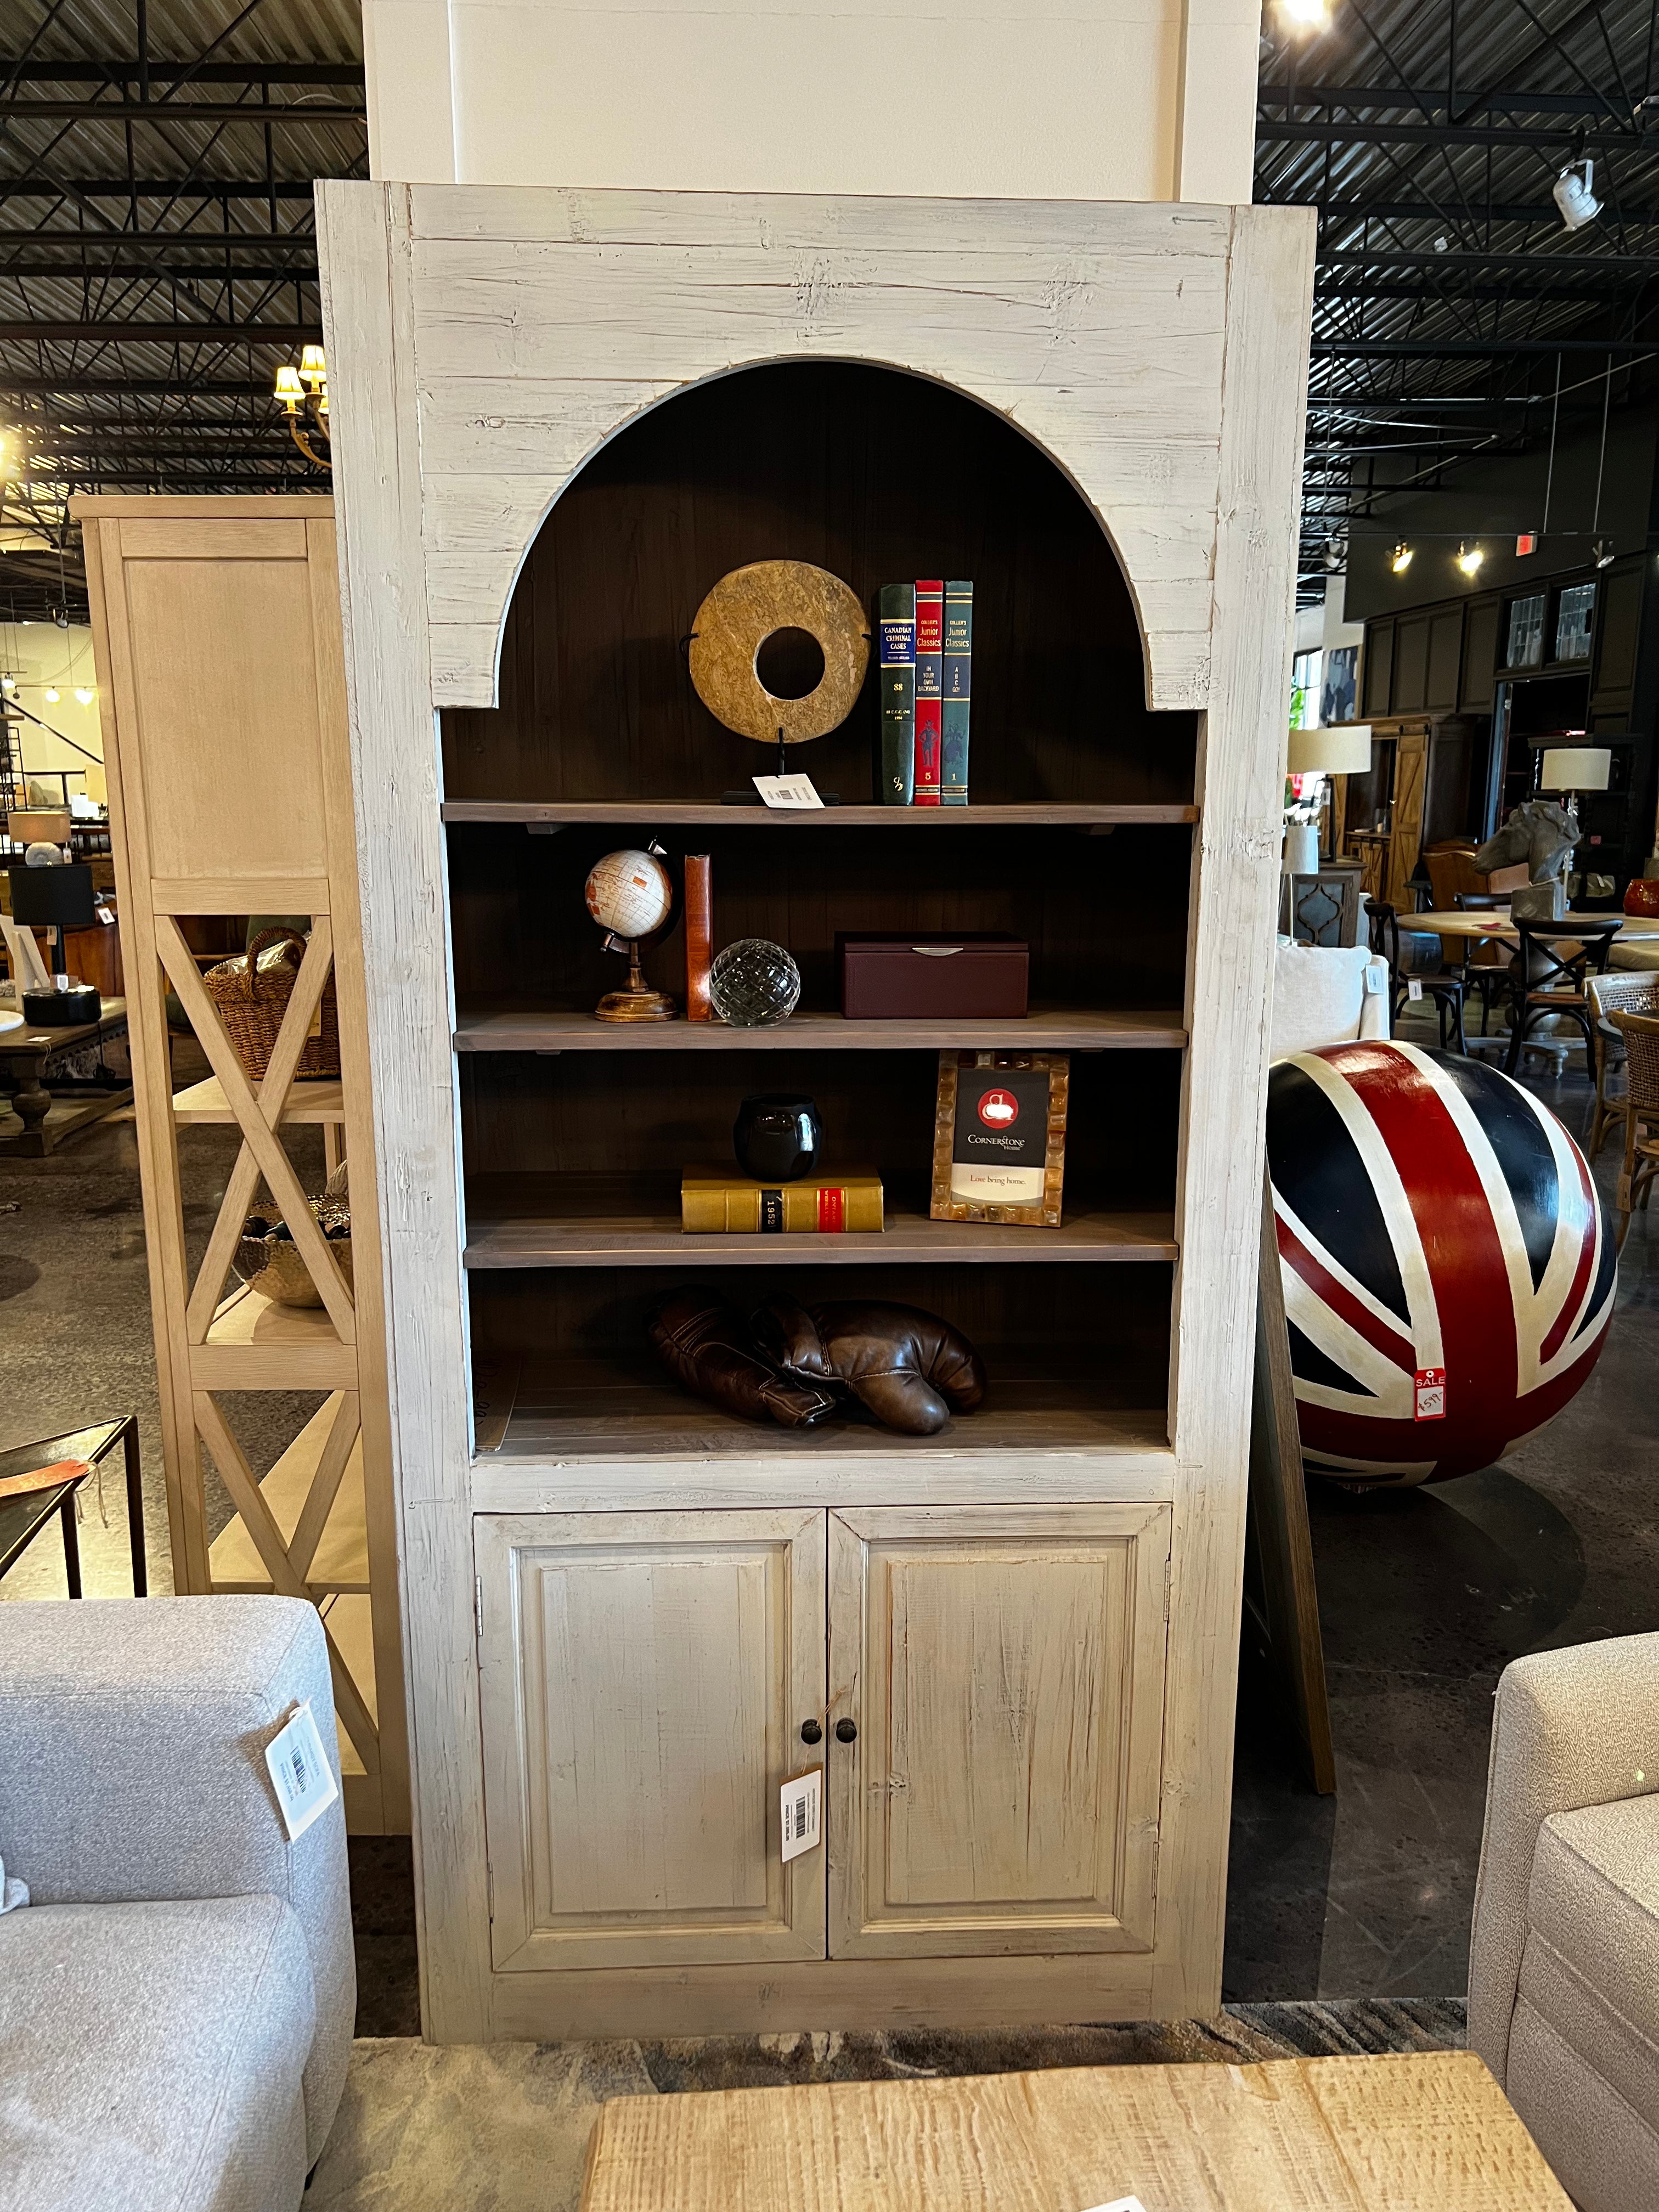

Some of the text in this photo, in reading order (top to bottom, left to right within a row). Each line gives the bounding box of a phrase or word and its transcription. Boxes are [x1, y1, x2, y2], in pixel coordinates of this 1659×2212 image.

[920, 627, 938, 635] Junior
[949, 627, 967, 636] Junior
[917, 637, 941, 646] Classics
[945, 638, 969, 647] Classics
[988, 1176, 1005, 1186] being
[1416, 1376, 1445, 1387] SALE
